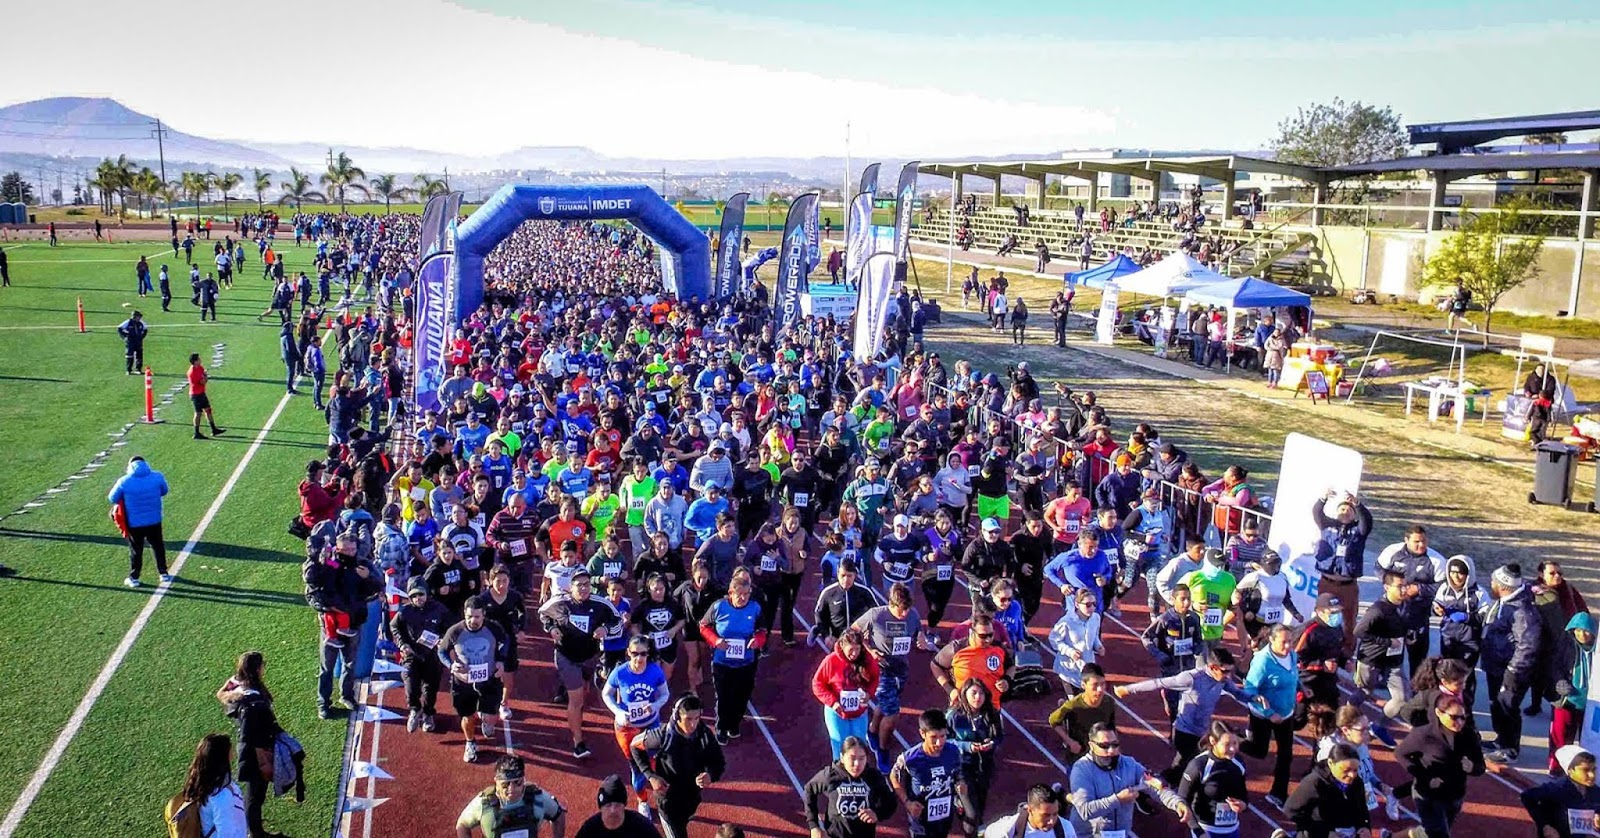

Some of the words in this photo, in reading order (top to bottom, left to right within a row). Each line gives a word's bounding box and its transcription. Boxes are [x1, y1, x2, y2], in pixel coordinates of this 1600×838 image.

[593, 199, 632, 210] IMDET
[721, 239, 734, 297] OWERADE
[783, 235, 803, 325] POWERADE
[427, 281, 444, 361] TIJUANA
[727, 644, 743, 655] 2199
[469, 669, 487, 680] 1659
[840, 800, 866, 814] 664
[929, 802, 948, 816] 2195
